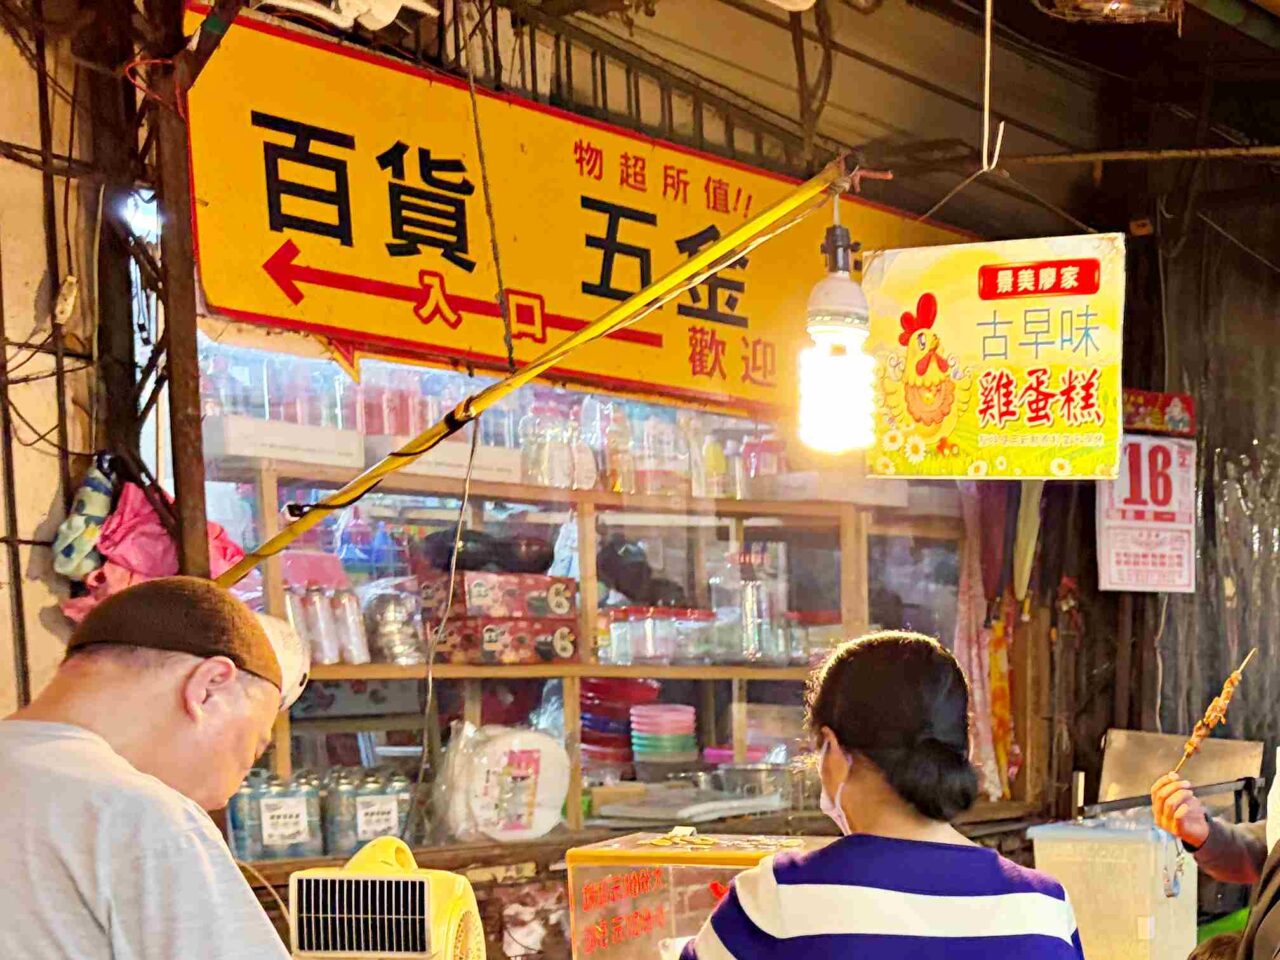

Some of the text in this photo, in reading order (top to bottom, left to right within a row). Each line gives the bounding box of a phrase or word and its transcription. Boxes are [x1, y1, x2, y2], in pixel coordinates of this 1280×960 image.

[249, 110, 476, 273] 百貨
[572, 138, 753, 219] 物超所值!!
[580, 196, 751, 329] 五金
[996, 265, 1080, 294] 景美廖家
[414, 271, 548, 344] 入口
[976, 304, 1100, 361] 古早味
[687, 326, 778, 389] 歡迎
[977, 366, 1104, 427] 雞蛋糕
